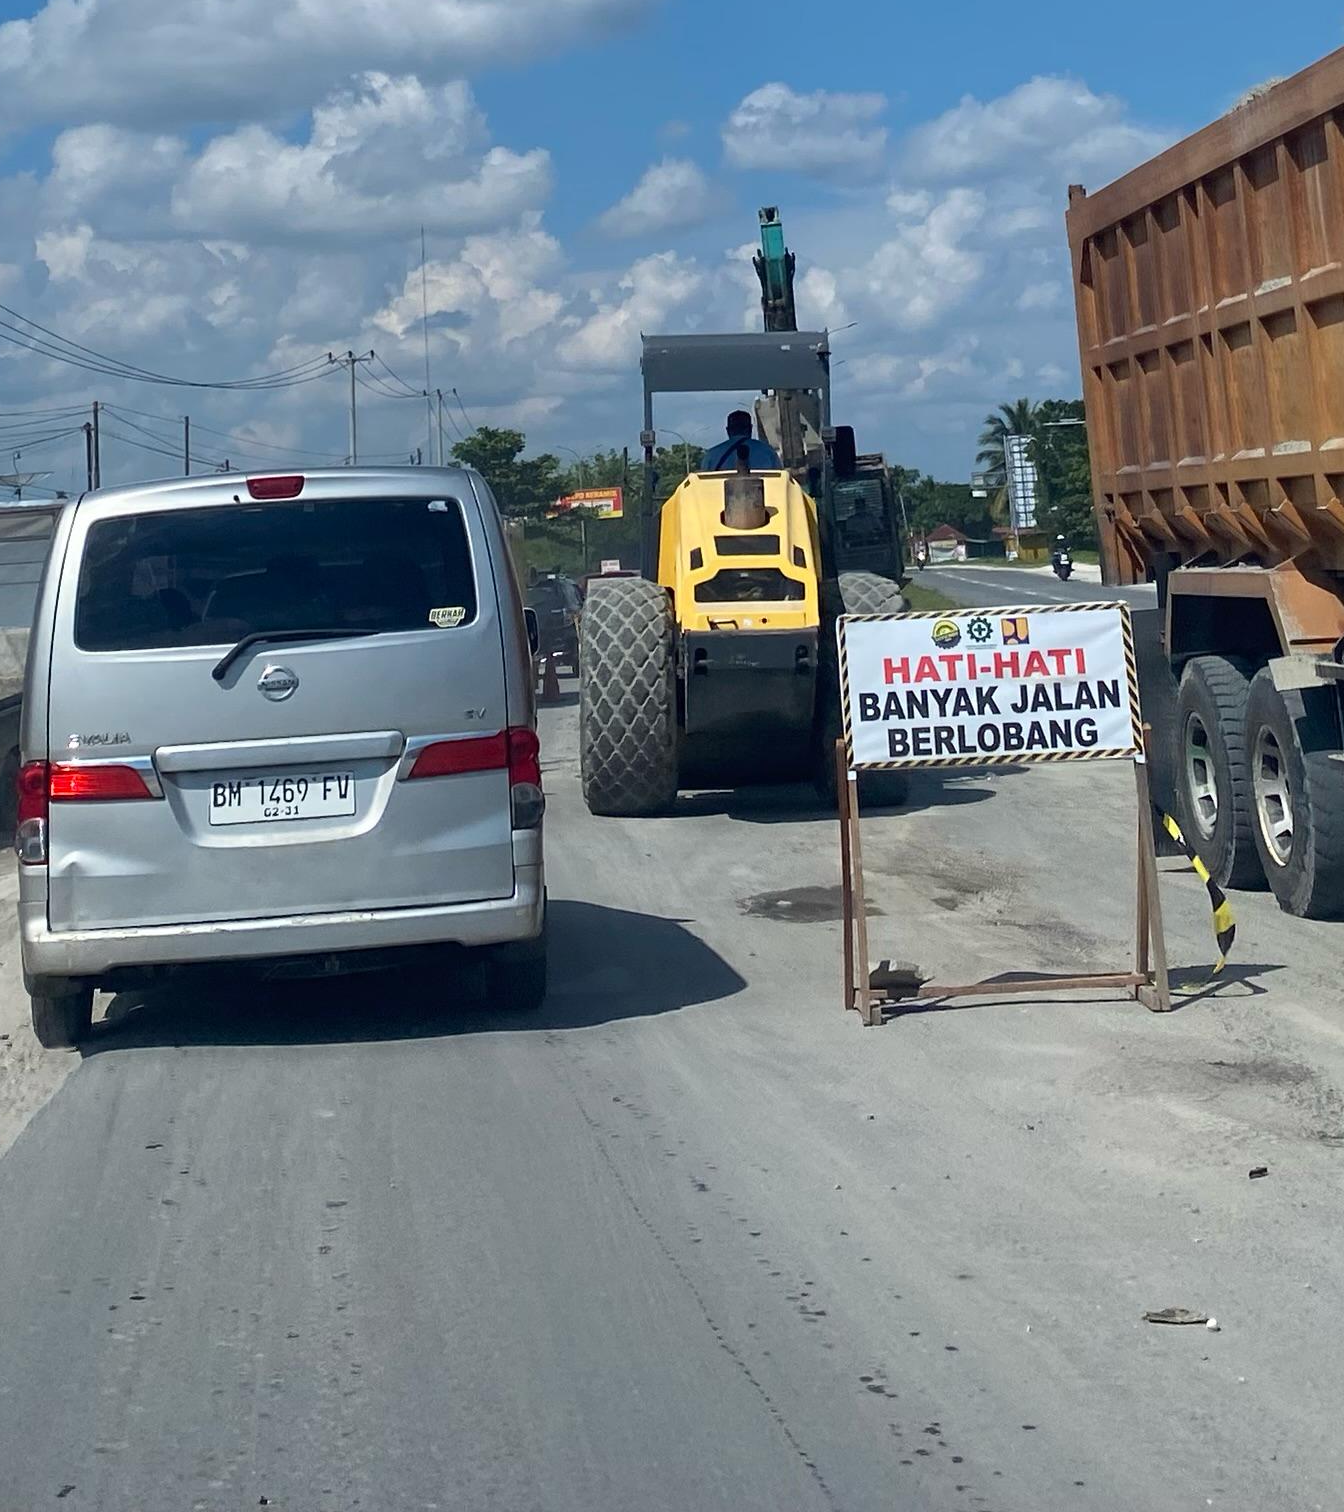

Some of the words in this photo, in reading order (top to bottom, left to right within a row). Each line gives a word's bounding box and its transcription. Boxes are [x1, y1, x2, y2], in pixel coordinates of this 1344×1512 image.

[883, 647, 1087, 684] HATI-HATI
[859, 685, 1001, 722] BANYAK
[1010, 679, 1121, 714] JALAN
[887, 717, 1099, 758] BERLOBANG
[213, 781, 242, 807] BM
[258, 777, 309, 805] 1469
